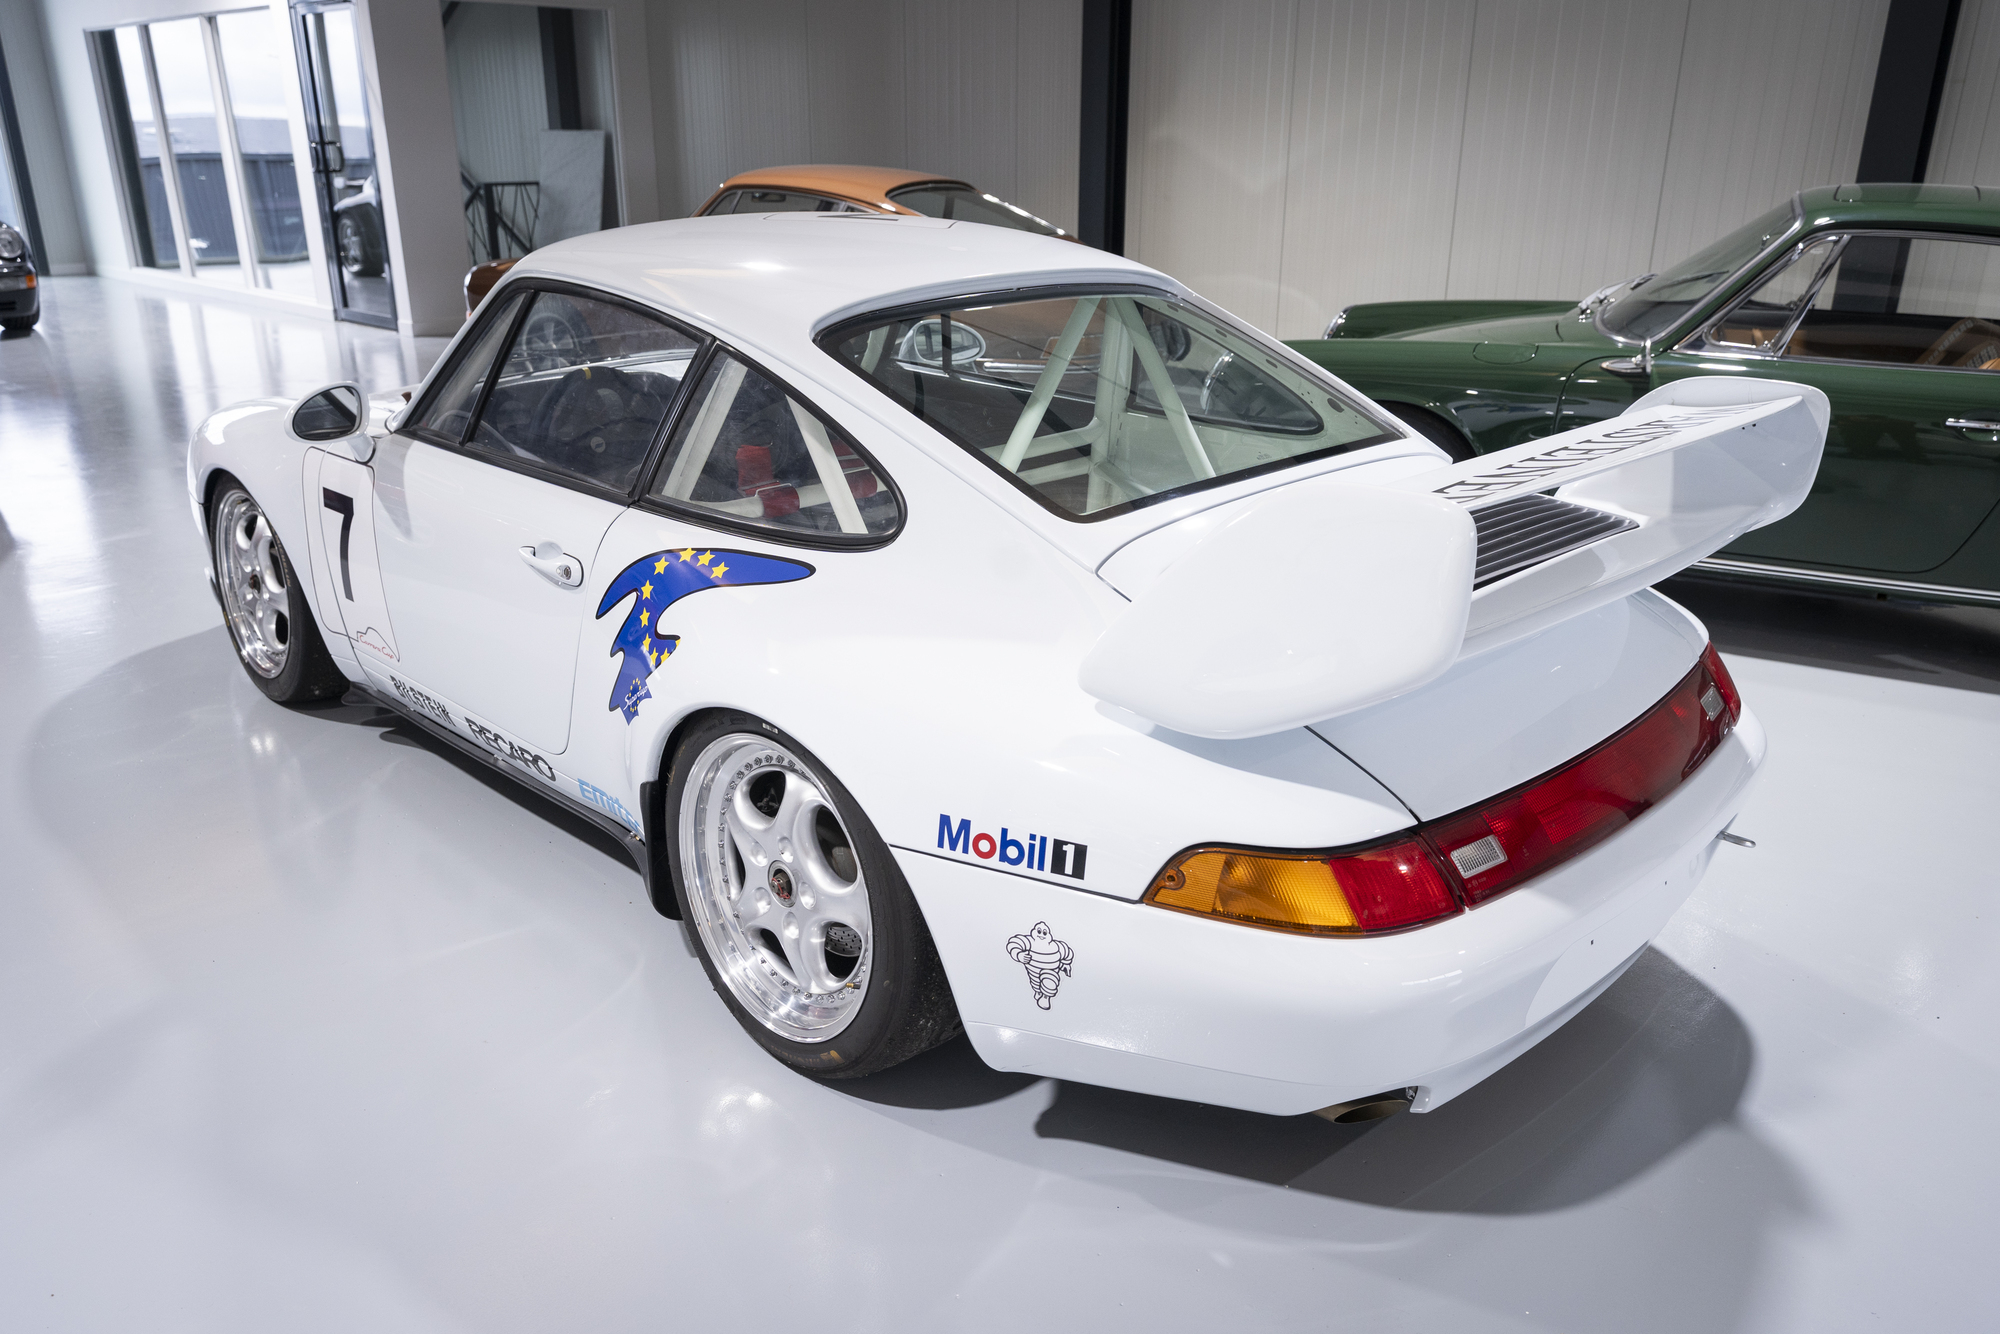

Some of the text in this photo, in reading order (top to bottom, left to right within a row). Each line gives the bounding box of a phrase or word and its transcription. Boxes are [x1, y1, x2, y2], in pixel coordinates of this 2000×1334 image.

[322, 486, 355, 603] 7
[359, 634, 395, 660] Carrera Cup
[389, 674, 457, 728] BILSTEIN
[464, 716, 557, 783] RECARO
[937, 813, 1047, 872] Mobil
